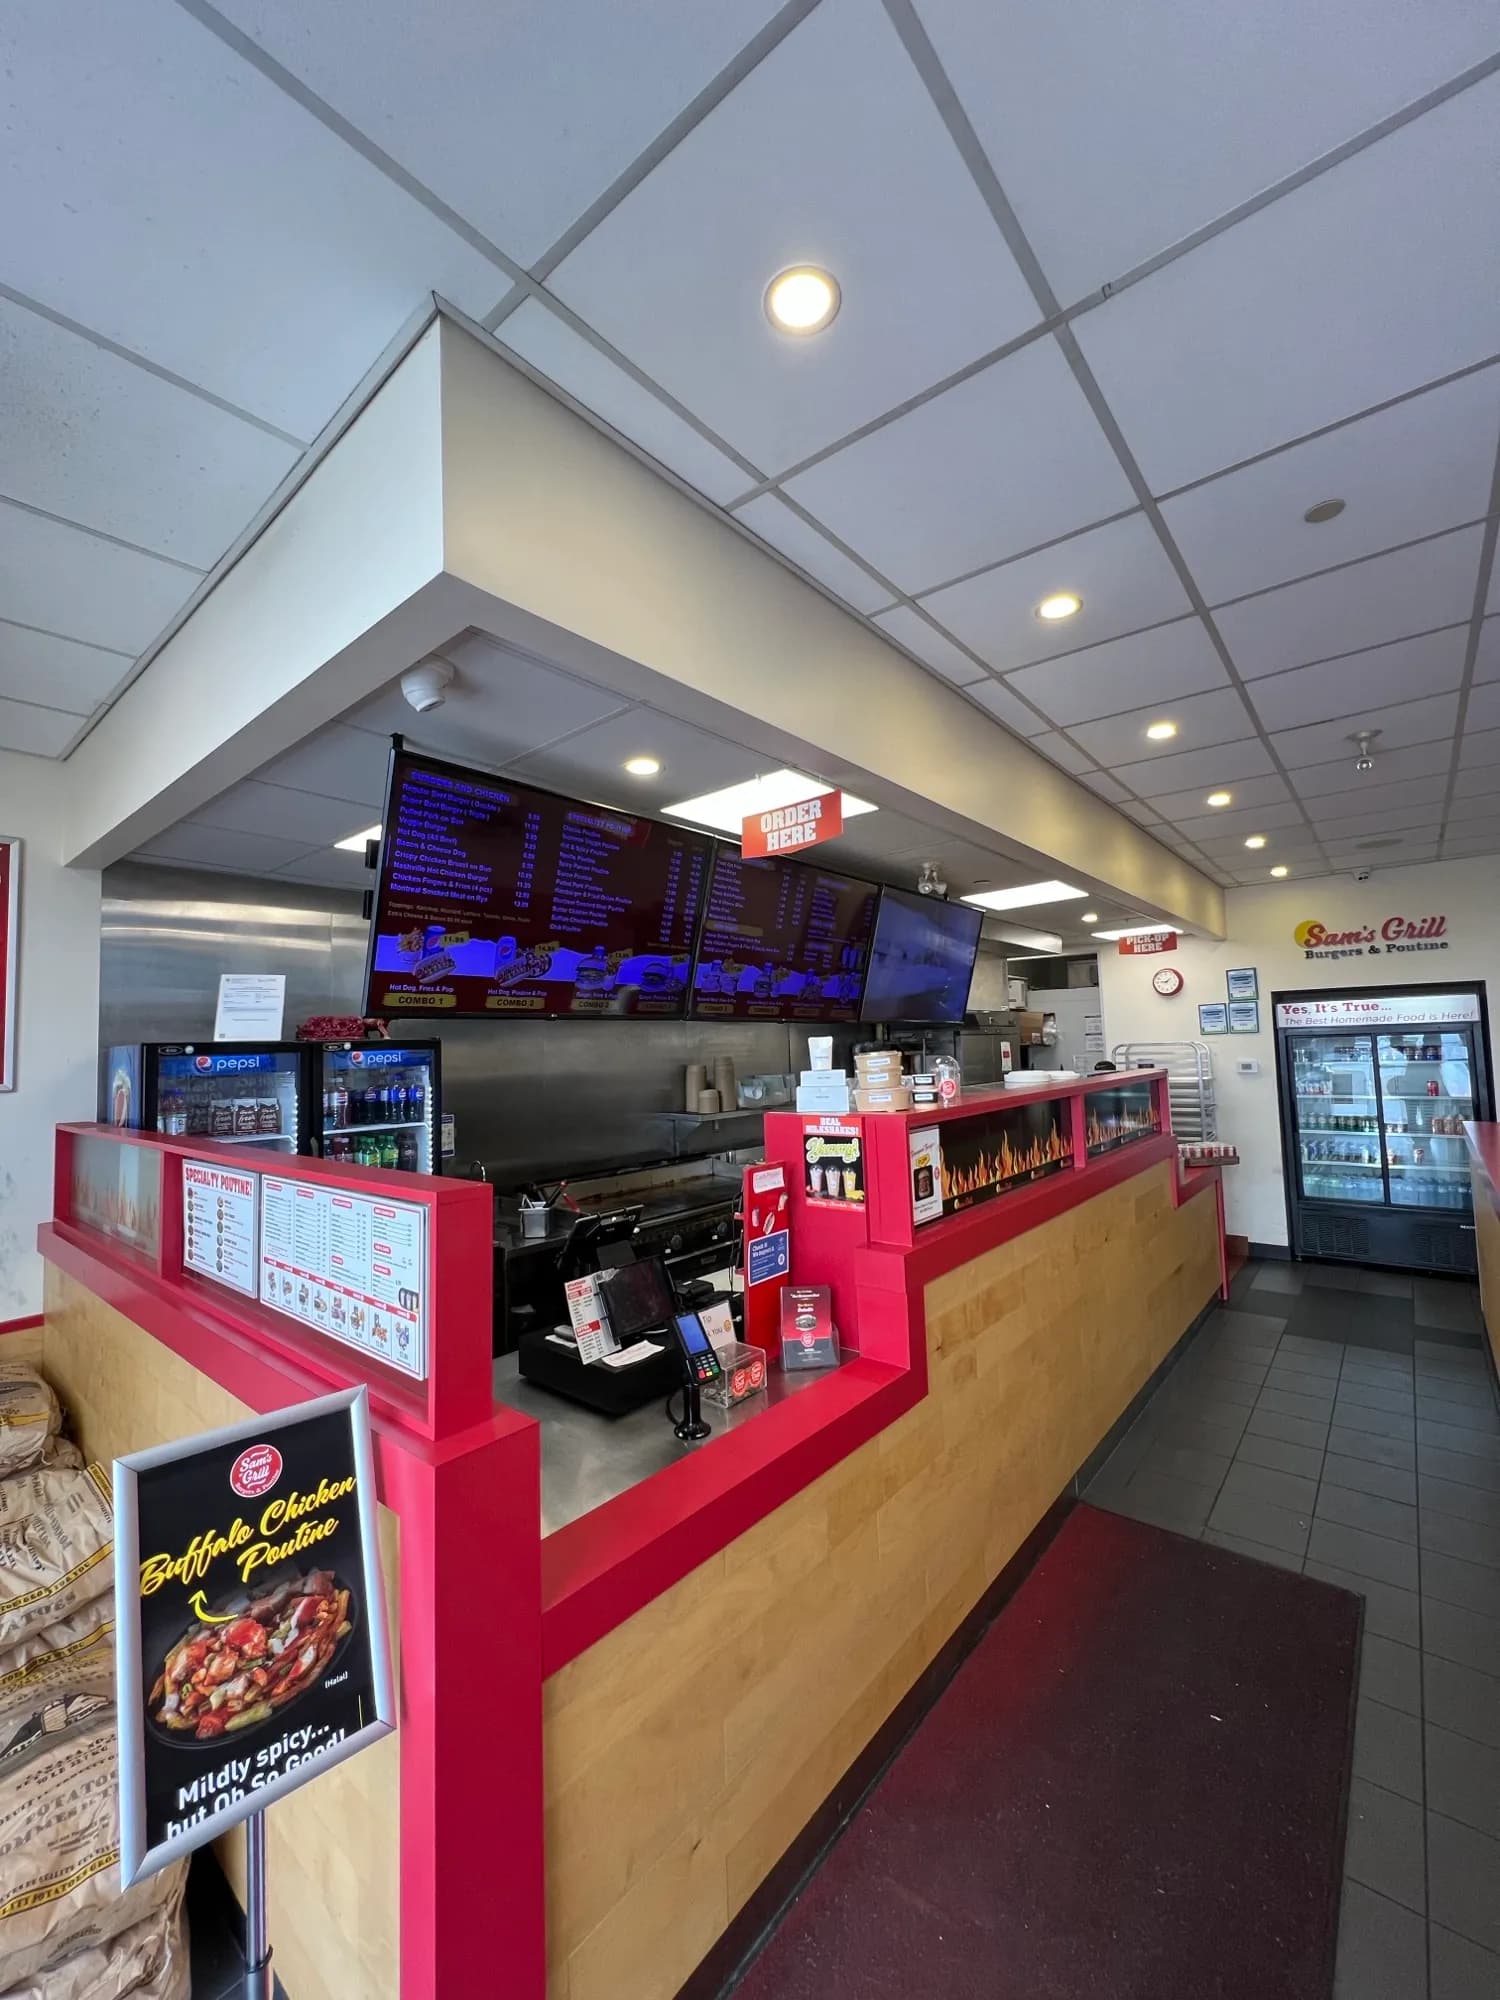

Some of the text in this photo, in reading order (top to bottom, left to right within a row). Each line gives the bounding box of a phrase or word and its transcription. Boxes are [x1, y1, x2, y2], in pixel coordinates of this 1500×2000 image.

[474, 788, 511, 803] CHICKEN
[761, 800, 822, 832] ORDER
[767, 821, 816, 852] HERE
[420, 854, 446, 864] Chicken
[392, 872, 421, 882] Chicken
[422, 888, 449, 897] Smoked
[1126, 934, 1168, 944] PICK-UP
[1304, 916, 1447, 948] Sam's Grill
[1134, 942, 1162, 952] HERE
[1305, 942, 1448, 960] Burgers & Poutine
[398, 996, 436, 1004] COMBO
[1282, 1002, 1392, 1016] Yes, It's True...
[1284, 1010, 1474, 1026] The Best Homemade Food is Here!
[216, 1056, 260, 1072] pepsi
[368, 1052, 402, 1065] pepsi
[820, 1117, 840, 1125] REAL
[186, 1167, 252, 1196] SPECIALTY POUTINE!
[240, 1454, 272, 1472] Sam's
[242, 1465, 270, 1484] Grill
[140, 1476, 356, 1596] Buffalo Chicken
[236, 1518, 340, 1583] Poutine
[324, 1671, 348, 1689] (Halal)
[178, 1724, 330, 1810] Mildly spicy...
[214, 1788, 245, 1812] Oh
